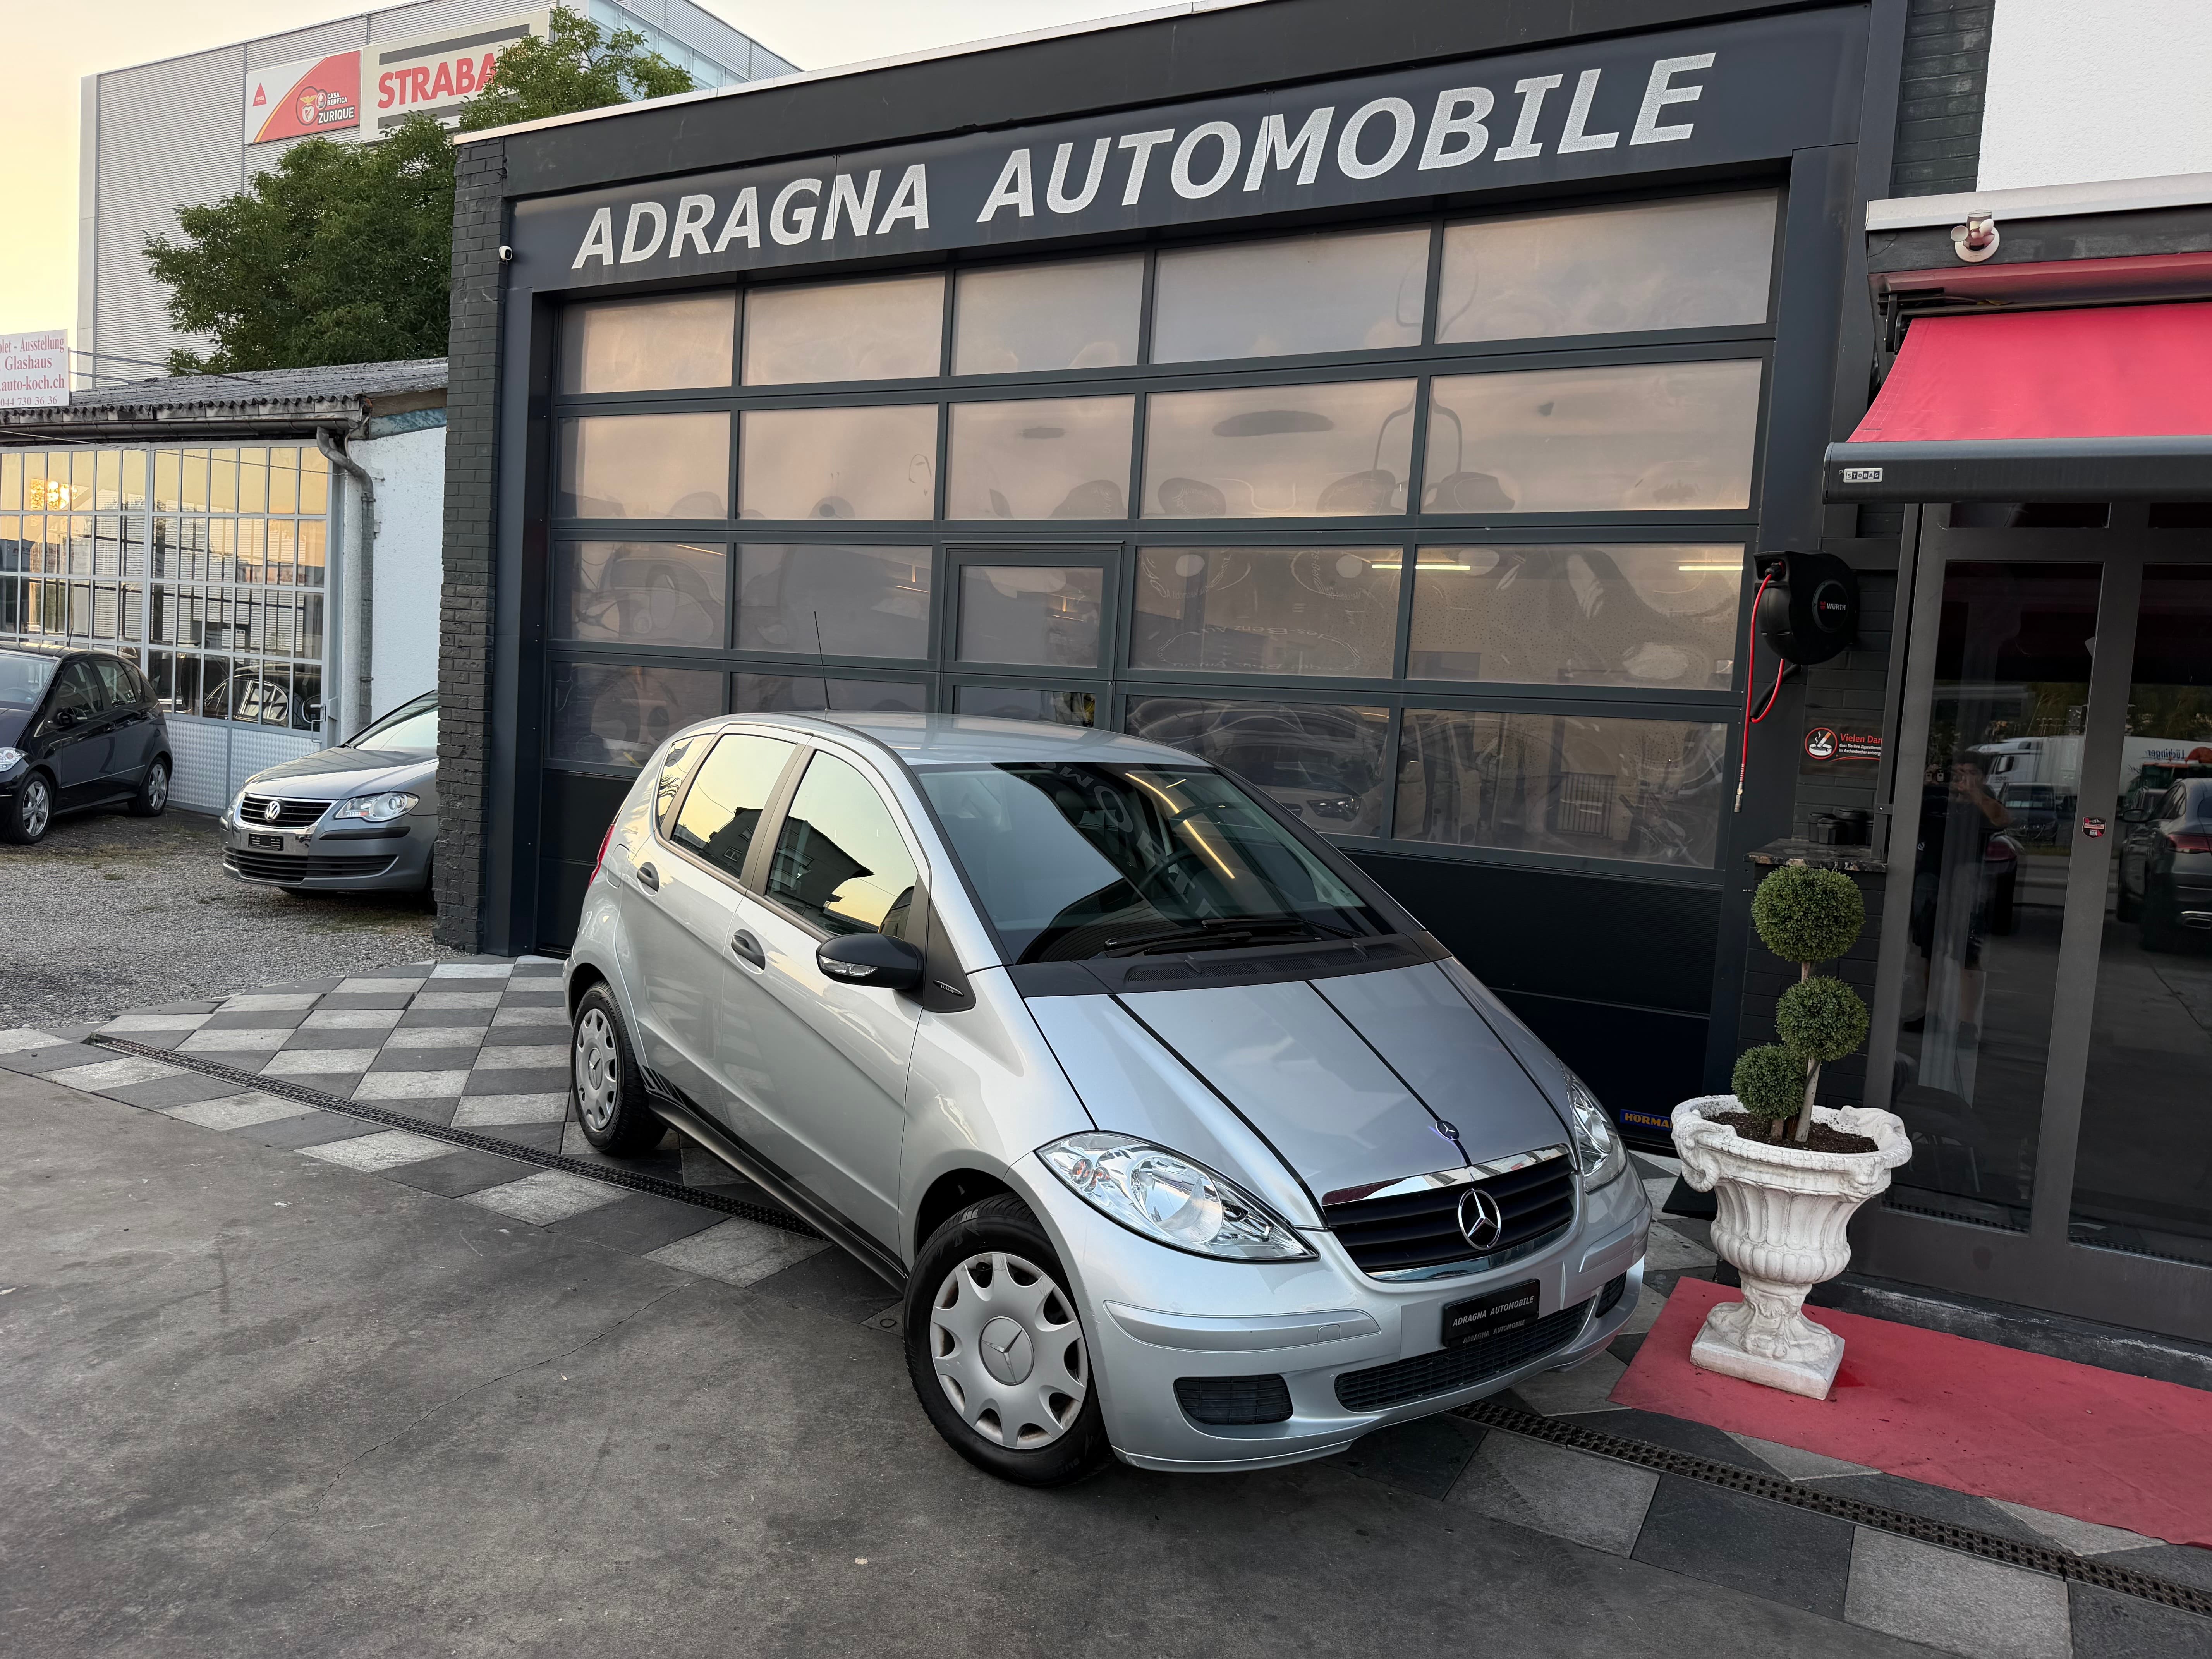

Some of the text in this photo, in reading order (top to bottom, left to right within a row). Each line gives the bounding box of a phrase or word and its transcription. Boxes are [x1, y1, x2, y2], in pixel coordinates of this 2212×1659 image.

[378, 53, 497, 109] STRABA
[327, 97, 347, 106] BENFICA
[318, 107, 354, 124] ZURIQUE
[571, 53, 1717, 269] ADRAGNA AUTOMOBILE
[20, 335, 64, 353] Ausstellung
[5, 355, 52, 371] Glashaus
[0, 398, 14, 406] 044
[17, 397, 31, 406] 730
[48, 395, 57, 405] 36
[1840, 733, 1882, 744] Vielen Dan
[1625, 1113, 1673, 1129] HÖRMA
[1452, 1296, 1534, 1327] ADRAGNA AUTOMOBILE
[1463, 1319, 1525, 1344] ADRAGNA AUTOMOBILE
